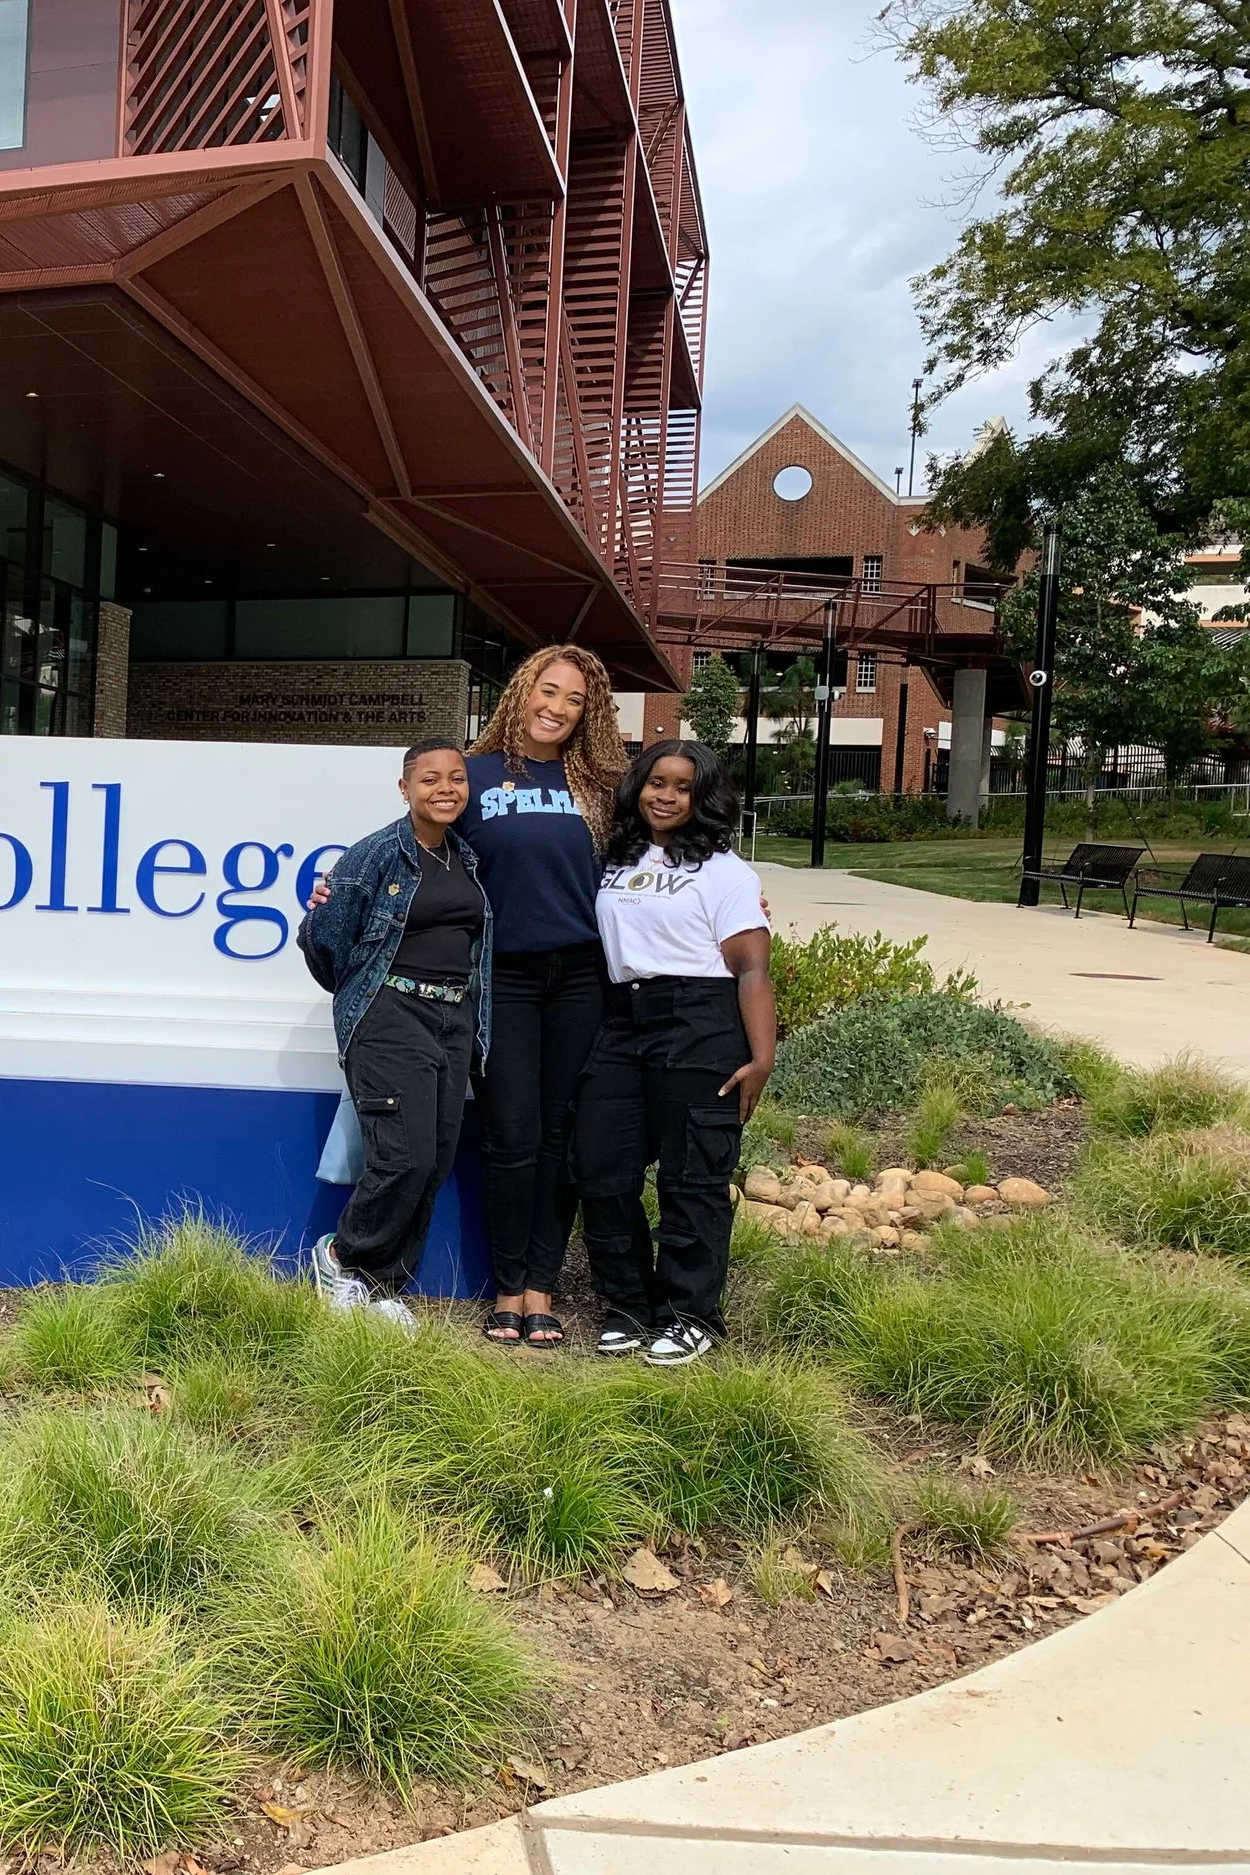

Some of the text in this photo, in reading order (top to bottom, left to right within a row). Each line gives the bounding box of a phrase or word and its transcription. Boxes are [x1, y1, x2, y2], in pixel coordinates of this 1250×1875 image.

[239, 694, 426, 706] MARY SCHMIDT CAMPBELL
[166, 710, 220, 722] CENTER
[252, 710, 340, 723] INNOVATION
[342, 711, 352, 723] &
[357, 711, 385, 723] THE
[389, 711, 426, 723] ARTS
[481, 787, 583, 820] SPELM
